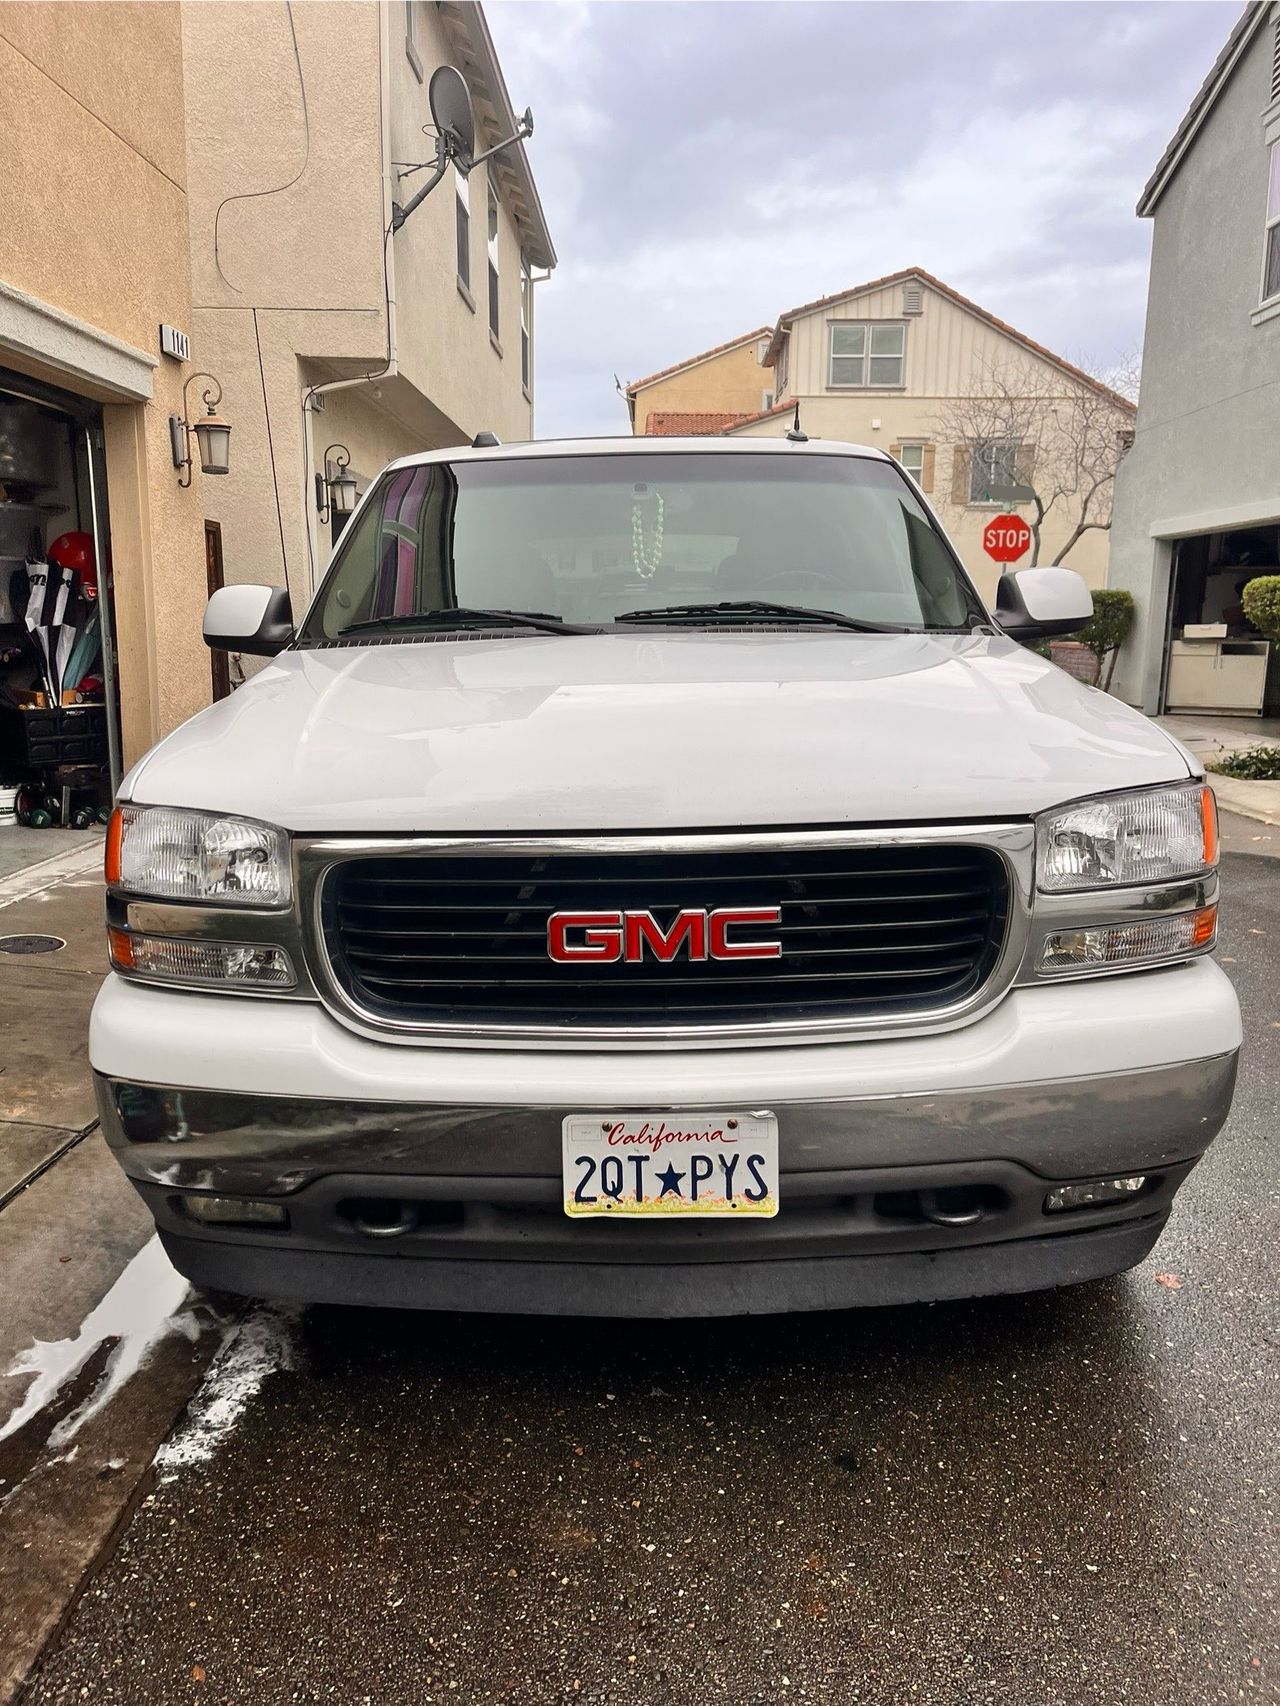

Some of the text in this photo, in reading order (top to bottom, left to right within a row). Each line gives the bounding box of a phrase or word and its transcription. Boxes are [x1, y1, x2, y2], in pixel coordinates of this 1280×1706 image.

[171, 329, 189, 359] 1141
[985, 529, 1030, 548] STOP
[547, 906, 782, 963] GMC
[607, 1122, 738, 1152] California
